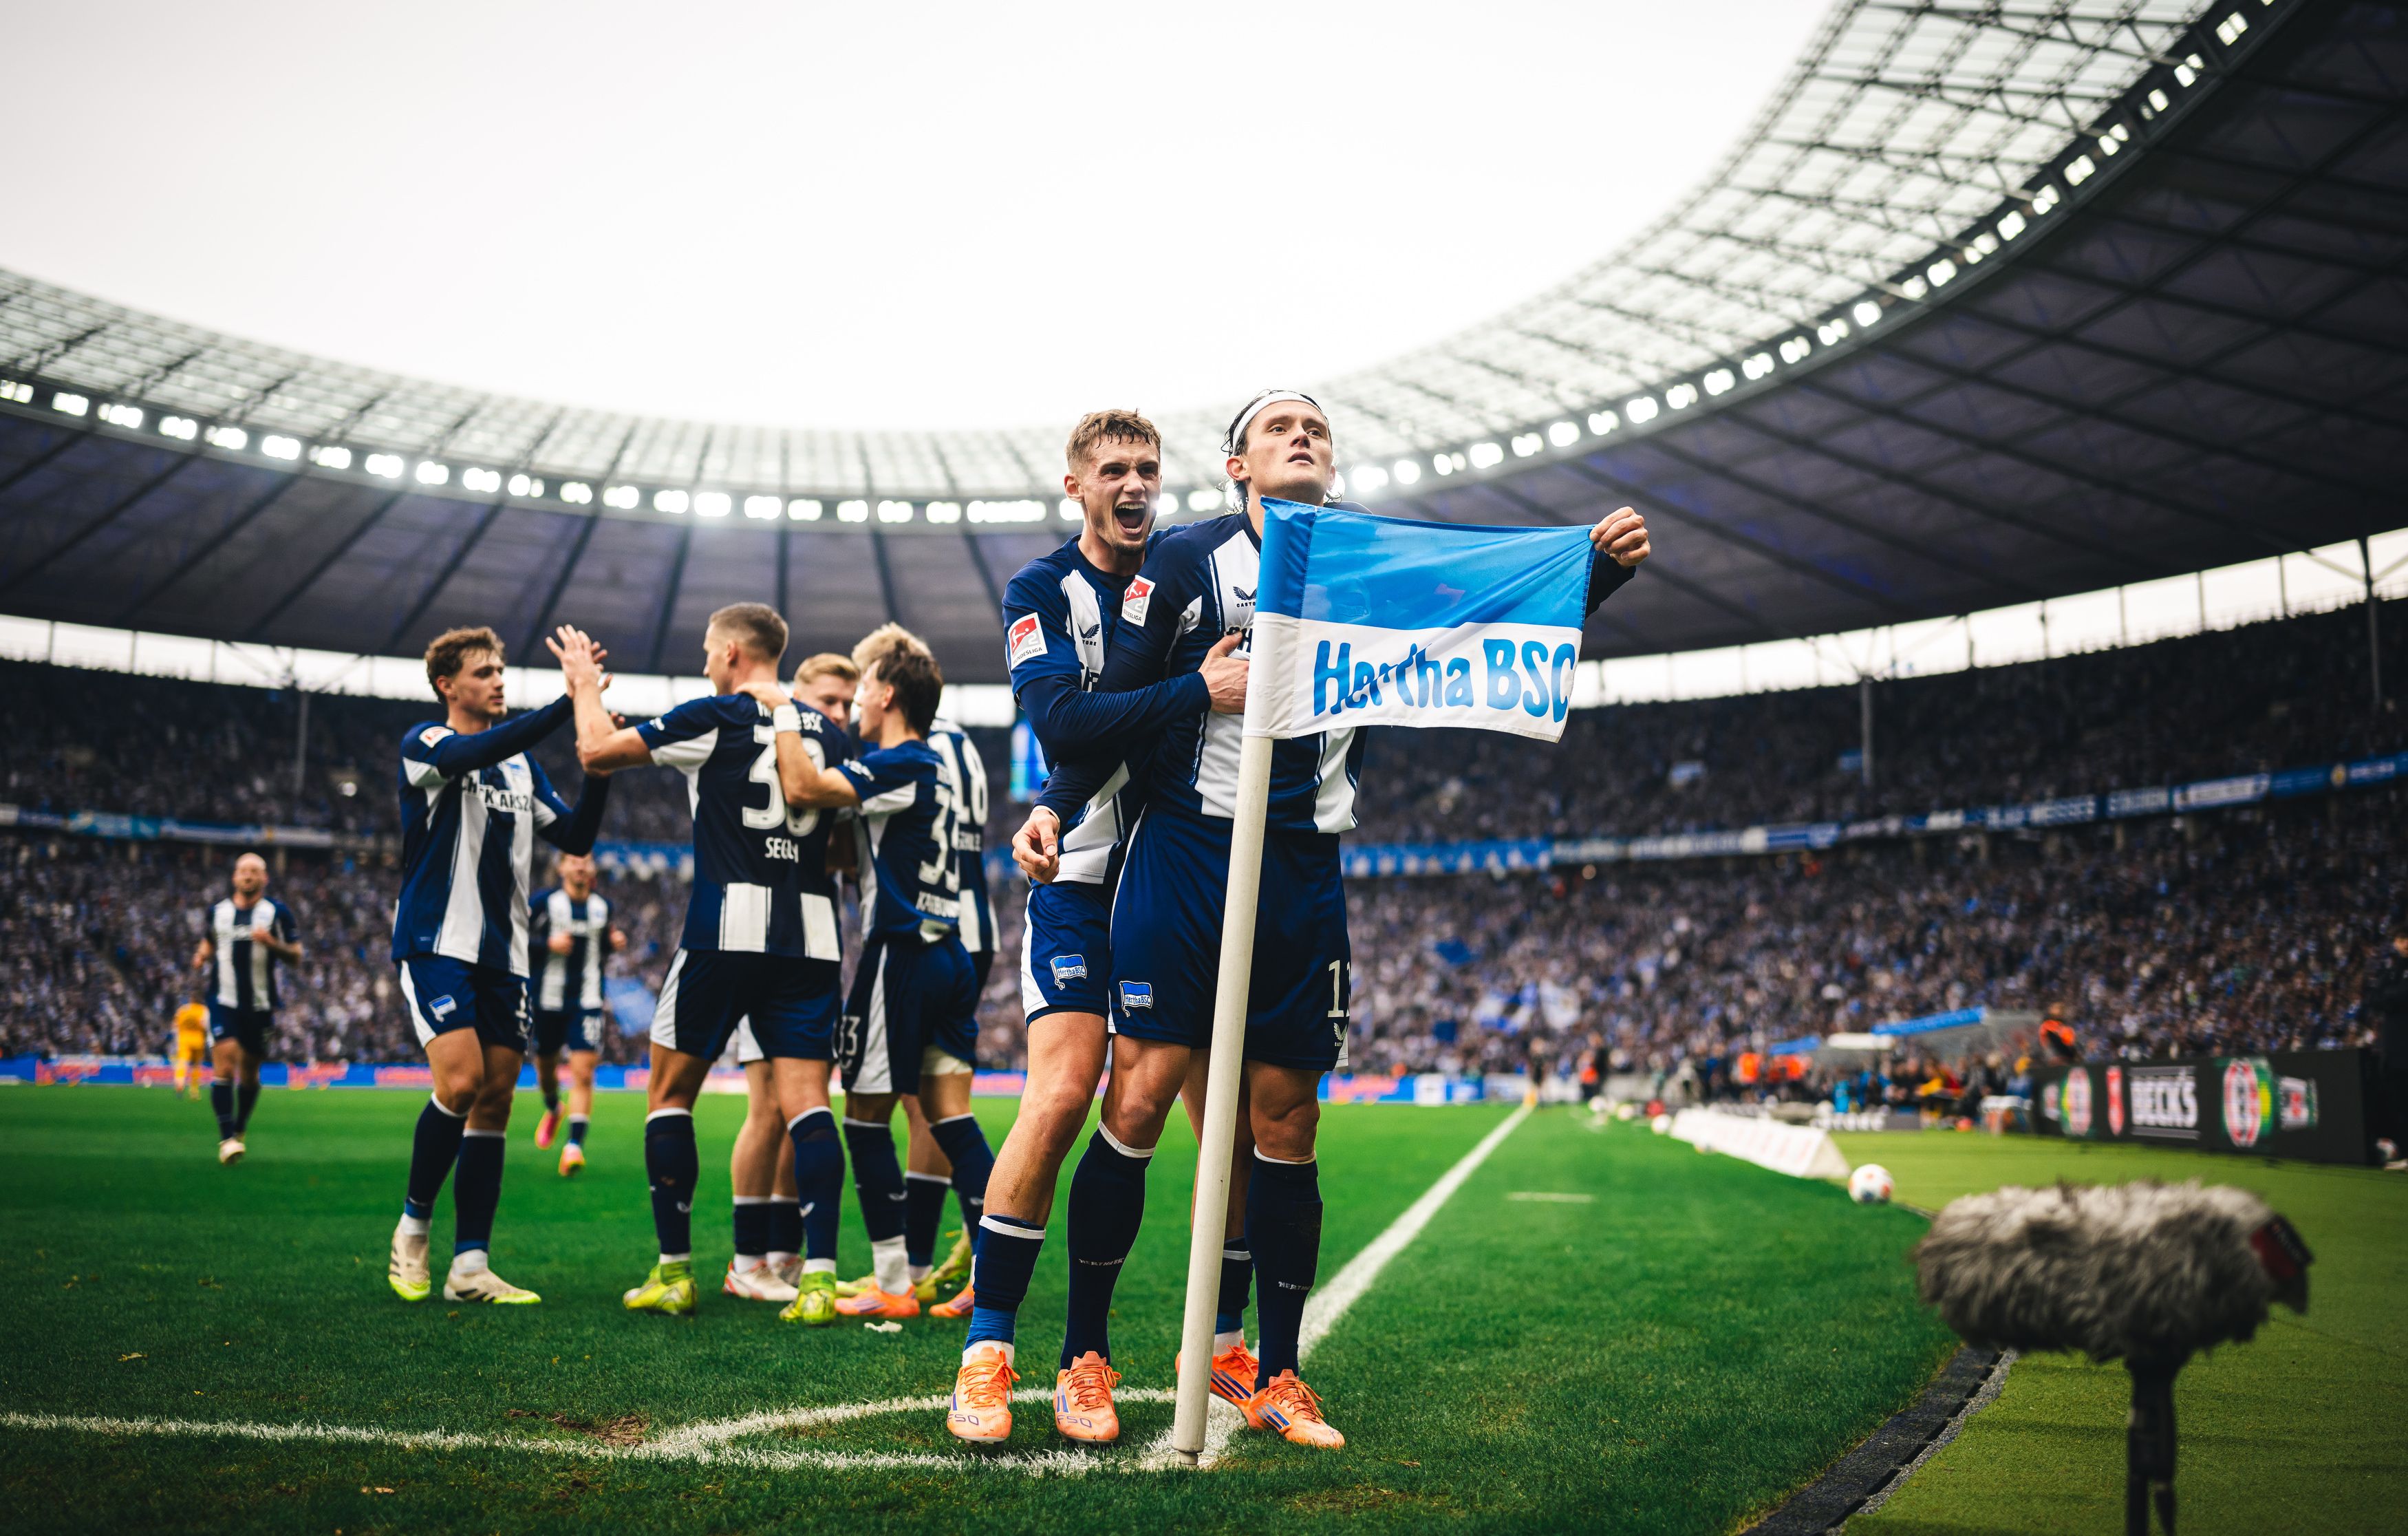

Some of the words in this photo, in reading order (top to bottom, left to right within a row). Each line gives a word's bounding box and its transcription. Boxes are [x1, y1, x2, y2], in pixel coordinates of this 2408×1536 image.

[1028, 632, 1039, 646] 2
[1013, 647, 1043, 665] BUNDESLIGA
[1313, 640, 1474, 717] Hertha
[1482, 639, 1576, 723] BSC
[947, 1414, 980, 1426] F50
[1057, 1415, 1093, 1428] F50
